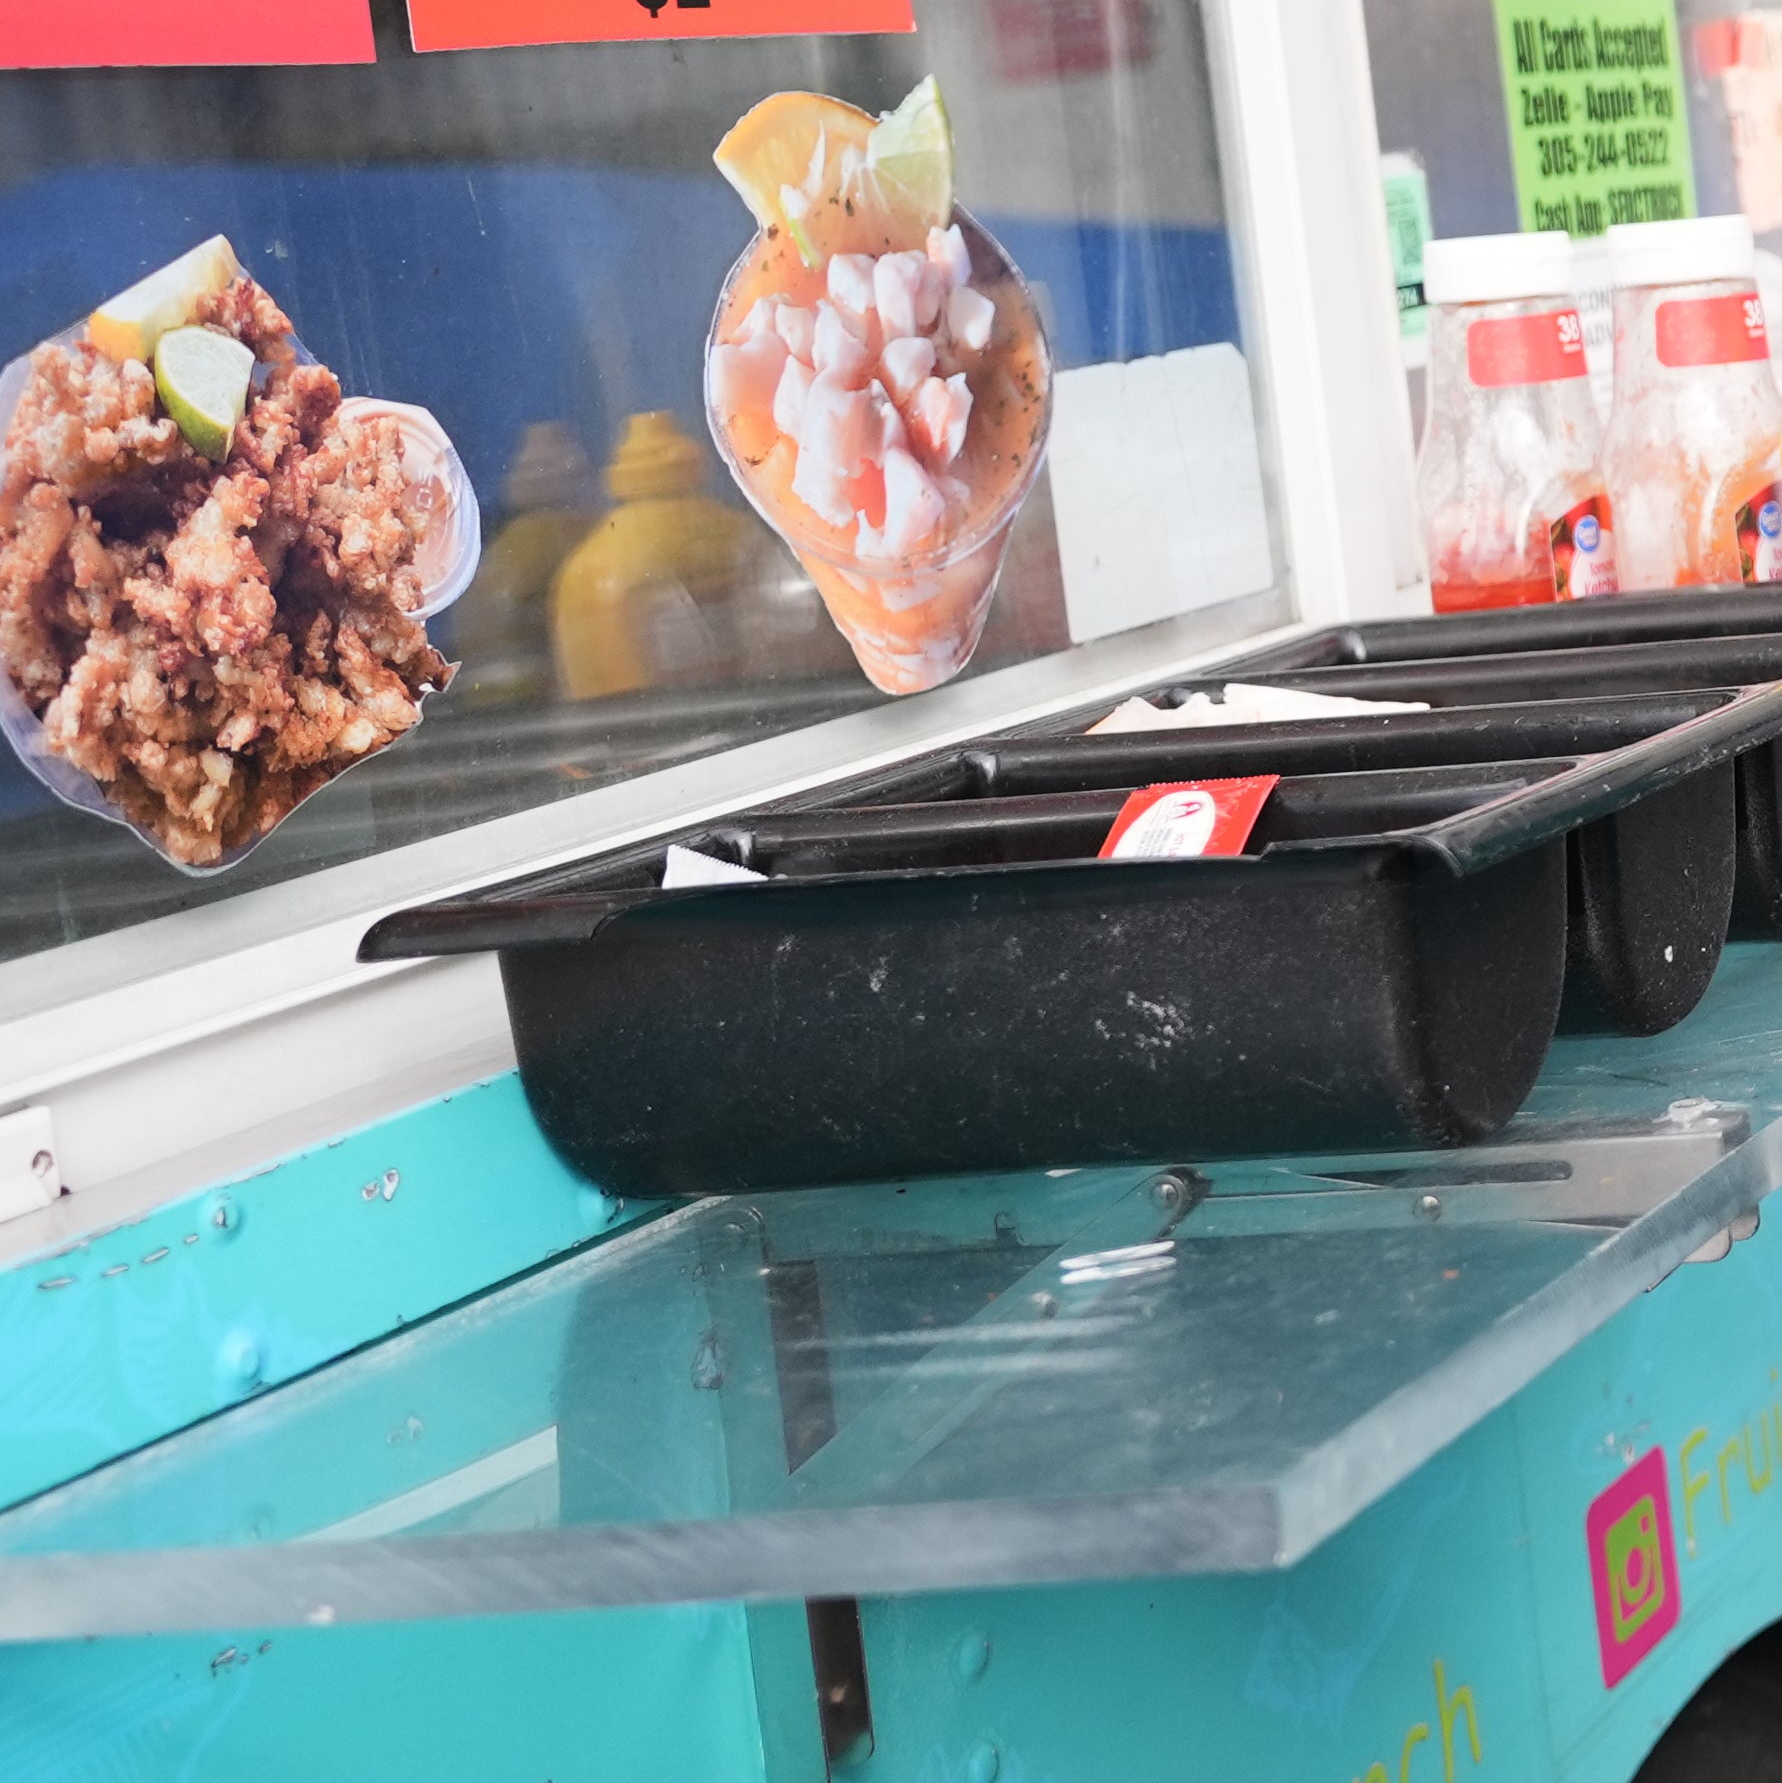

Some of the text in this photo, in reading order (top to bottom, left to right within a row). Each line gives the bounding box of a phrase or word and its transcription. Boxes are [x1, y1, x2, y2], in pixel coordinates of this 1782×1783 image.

[1513, 18, 1538, 75] All
[1539, 17, 1591, 72] Cards
[1521, 85, 1571, 128] Zelle
[1537, 129, 1669, 181] 305-244-0522
